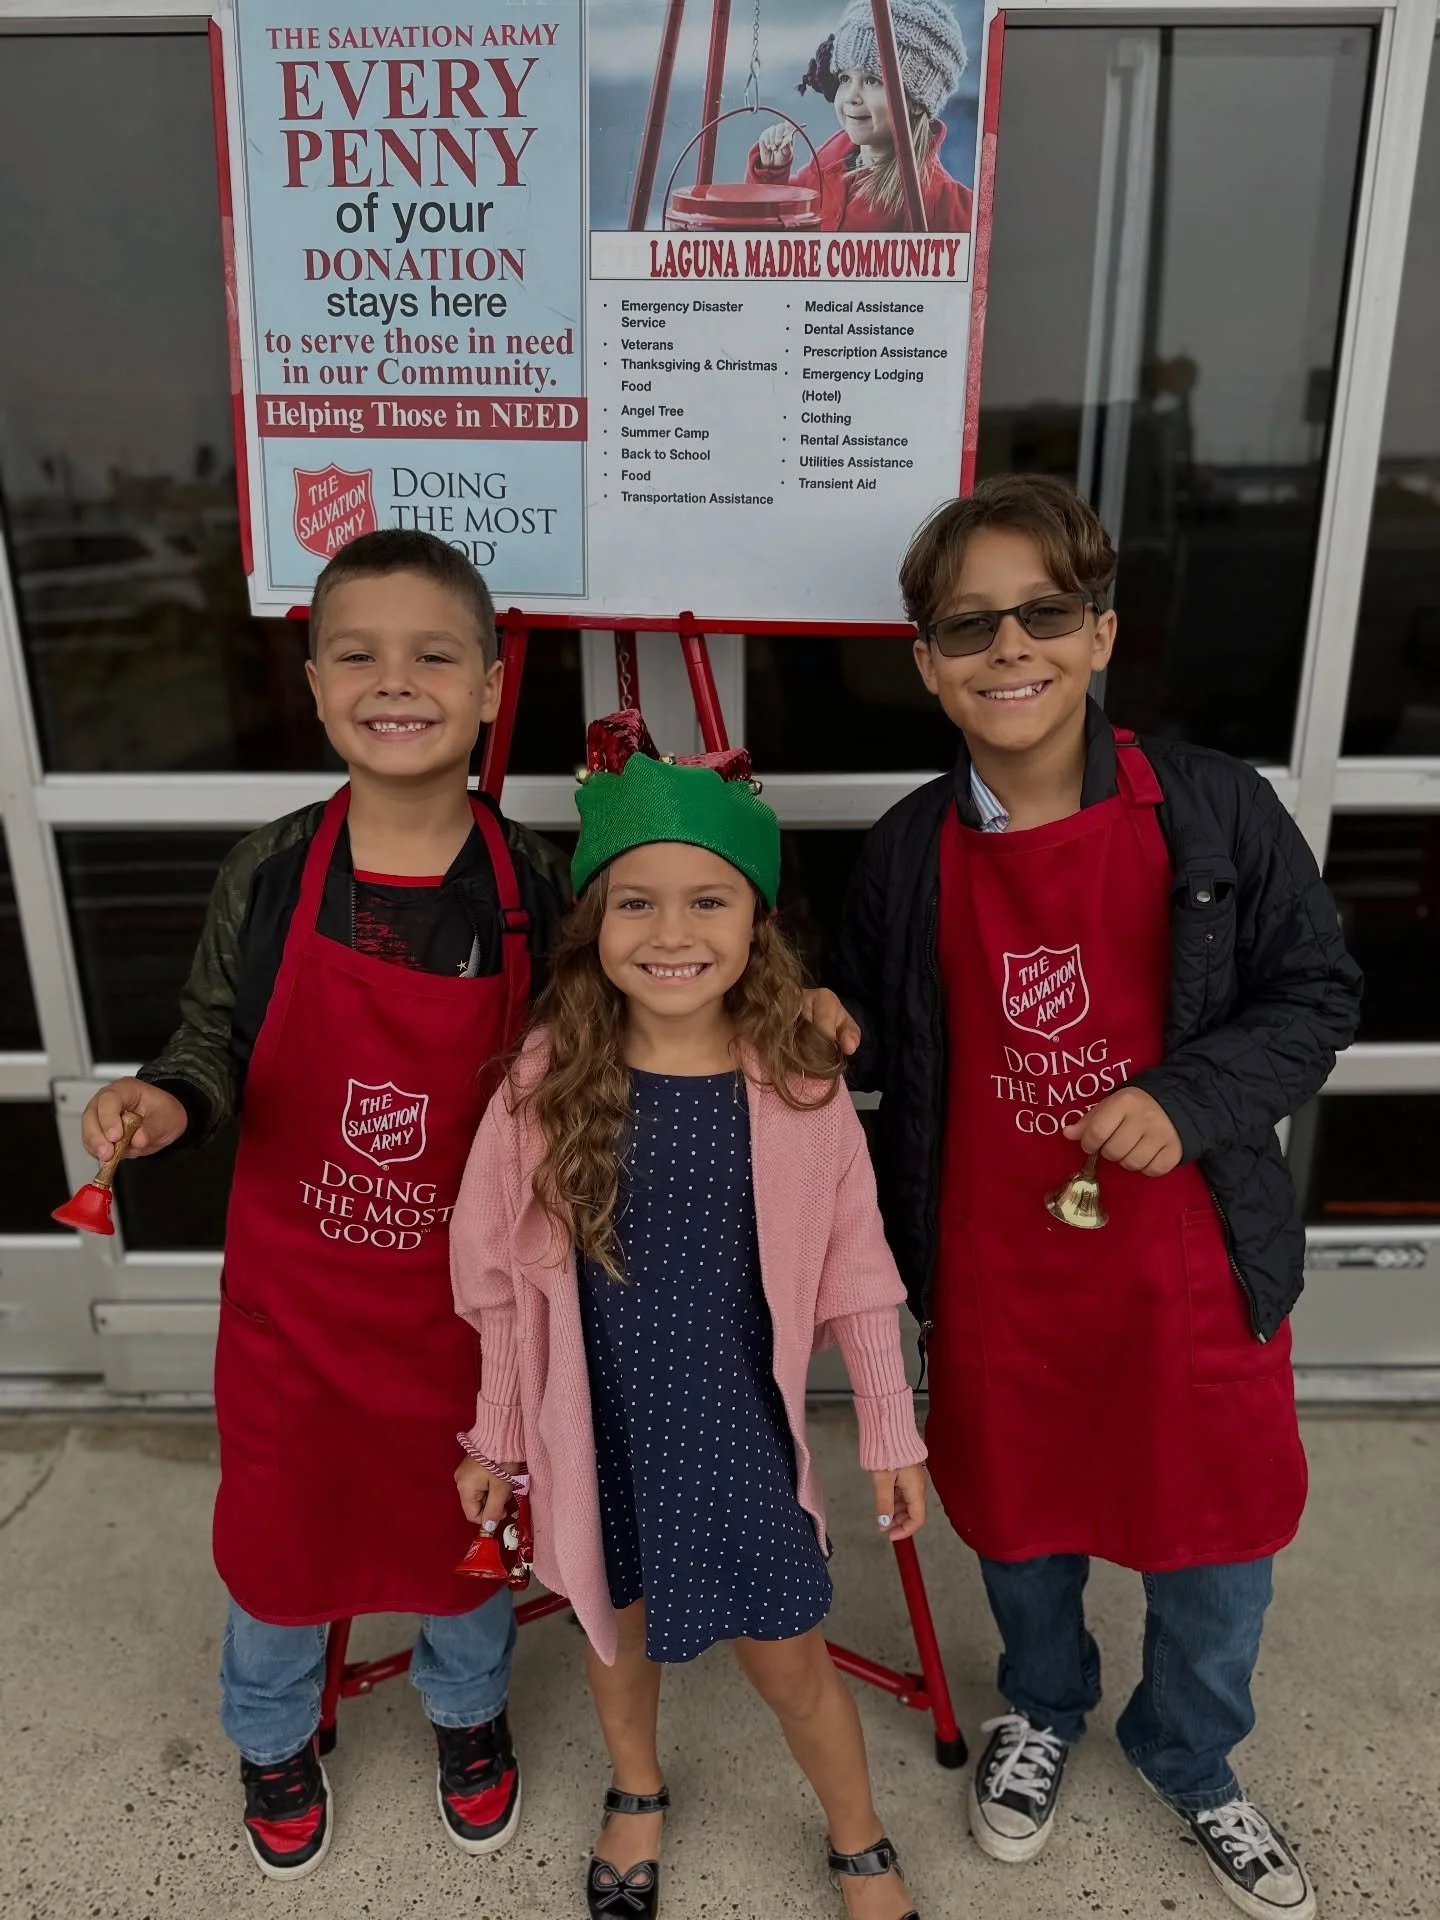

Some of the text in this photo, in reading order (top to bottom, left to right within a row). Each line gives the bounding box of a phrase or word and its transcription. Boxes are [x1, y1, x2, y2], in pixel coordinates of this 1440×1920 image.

[266, 24, 560, 49] THE SALVATION ARMY
[276, 58, 540, 121] EVERY
[280, 127, 539, 188] PENNY
[336, 192, 494, 243] of your
[302, 248, 527, 281] DONATION
[650, 239, 740, 278] LAGUNA
[744, 239, 822, 278] MADRE
[826, 238, 961, 278] COMMUNITY
[327, 285, 508, 324] stays here
[621, 300, 744, 314] Emergency Disaster
[805, 301, 924, 313] Medical Assistance
[621, 317, 666, 328] Service
[804, 324, 914, 336] Dental Assistance
[265, 327, 574, 355] to serve those in need
[621, 339, 674, 350] Veterans
[803, 346, 948, 359] Prescription Assistance
[282, 357, 557, 393] in our Community.
[621, 359, 778, 372] Thanksgiving & Christmas
[802, 368, 924, 383] Emergency Lodging
[621, 381, 652, 392] Food
[802, 390, 842, 403] (Hotel)
[264, 400, 579, 433] Helping Those in NEED
[621, 405, 684, 418] Angel Tree
[801, 412, 852, 426] Clothing
[621, 426, 710, 440] Summer Camp
[800, 434, 908, 446] Rental Assistance
[621, 448, 711, 461] Back to School
[799, 456, 913, 468] Utilities Assistance
[391, 467, 508, 500] DOING
[621, 470, 651, 481] Food
[799, 477, 876, 489] Transient Aid
[308, 475, 339, 506] THE
[621, 491, 774, 505] Transportation Assistance
[300, 480, 366, 540] SALVATION
[390, 505, 558, 534] THE MOST
[325, 508, 366, 553] ARMY
[1018, 955, 1050, 987] THE
[1009, 956, 1076, 1017] SALVATION
[1036, 982, 1076, 1028] ARMY
[1004, 1039, 1108, 1076] DOING
[990, 1058, 1132, 1107] THE MOST
[360, 1093, 393, 1115] THE
[348, 1102, 419, 1137] SALVATION
[1015, 1102, 1100, 1136] GOO
[370, 1127, 414, 1152] ARMY
[321, 1160, 437, 1204] DOING
[300, 1180, 455, 1227] THE MOST
[320, 1218, 421, 1250] GOOD
